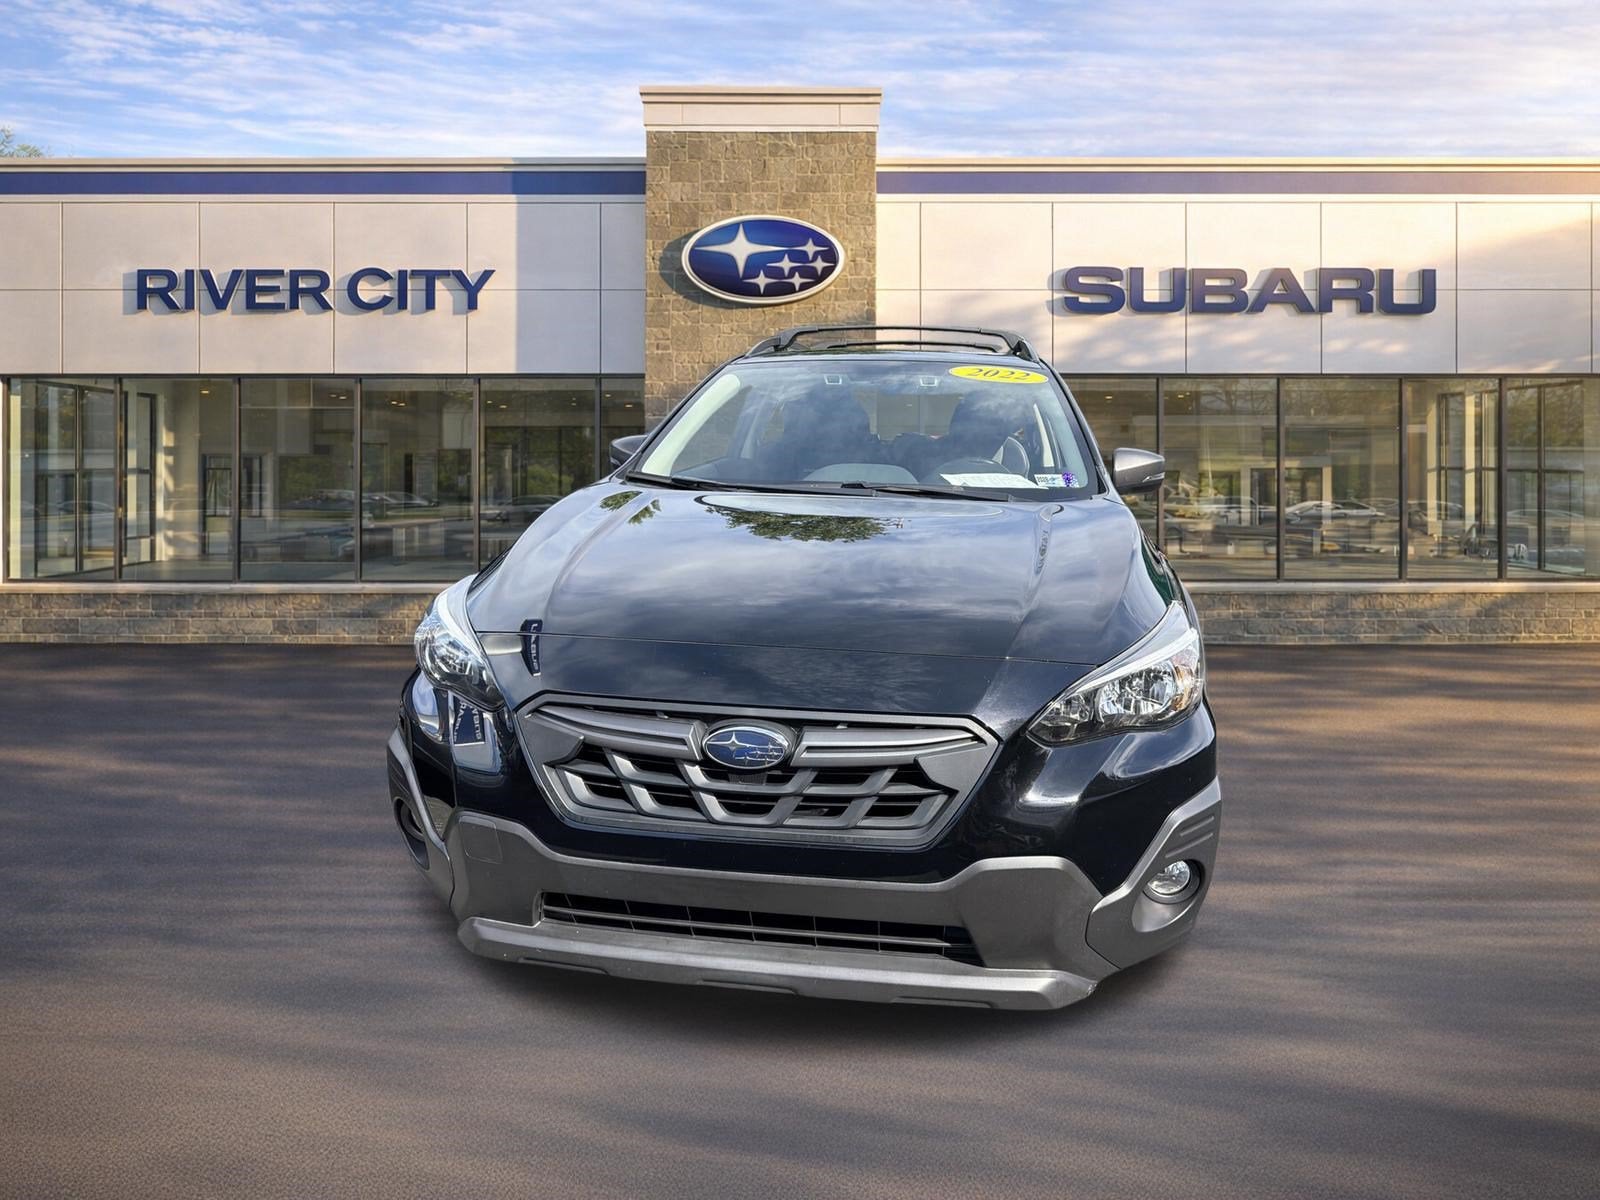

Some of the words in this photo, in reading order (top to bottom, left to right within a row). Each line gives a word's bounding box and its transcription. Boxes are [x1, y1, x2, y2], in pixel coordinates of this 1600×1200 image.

[136, 268, 334, 311] RIVER
[347, 266, 496, 311] CITY
[1063, 266, 1437, 315] SUBARU
[967, 367, 1031, 380] 2022
